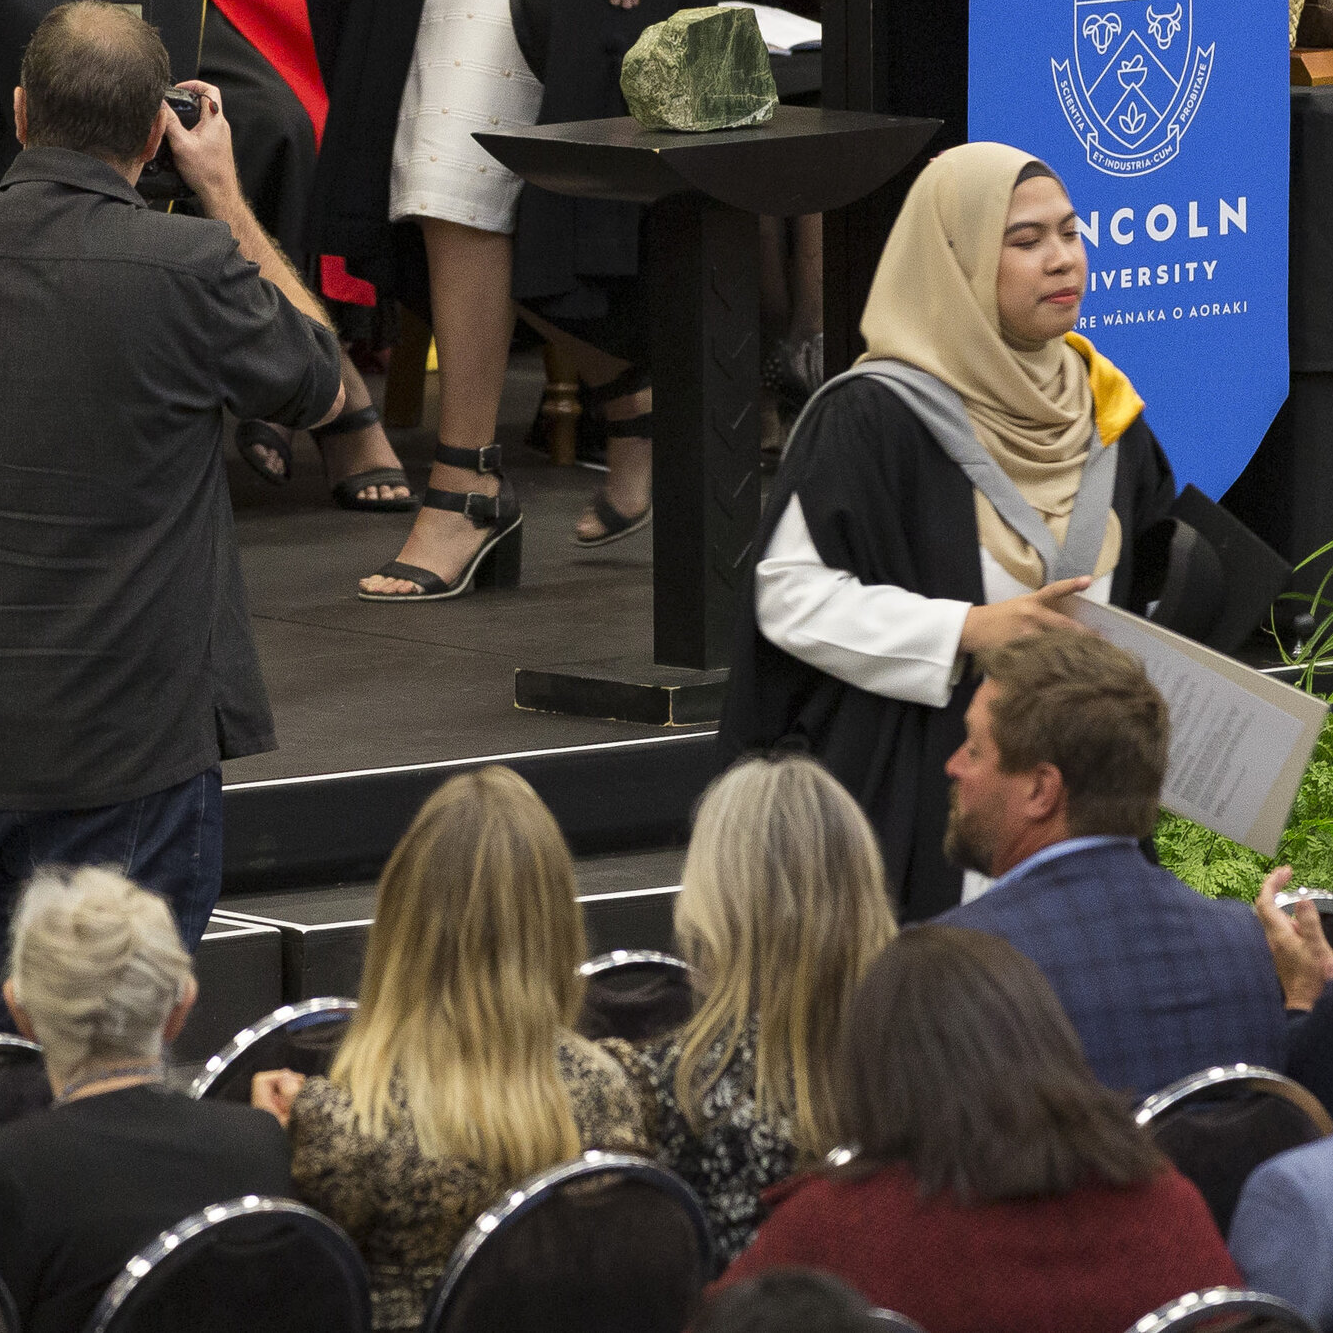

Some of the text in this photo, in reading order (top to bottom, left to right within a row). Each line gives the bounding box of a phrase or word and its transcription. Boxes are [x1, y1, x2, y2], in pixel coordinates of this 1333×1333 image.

[1060, 80, 1085, 131] SCIENTIA
[1179, 63, 1207, 122] PROBITATE
[1074, 196, 1247, 249] NCOLN
[1090, 260, 1218, 292] IVERSITY
[1103, 309, 1166, 326] WĀNAKA
[1172, 307, 1183, 320] O
[1189, 300, 1248, 318] AORAKI
